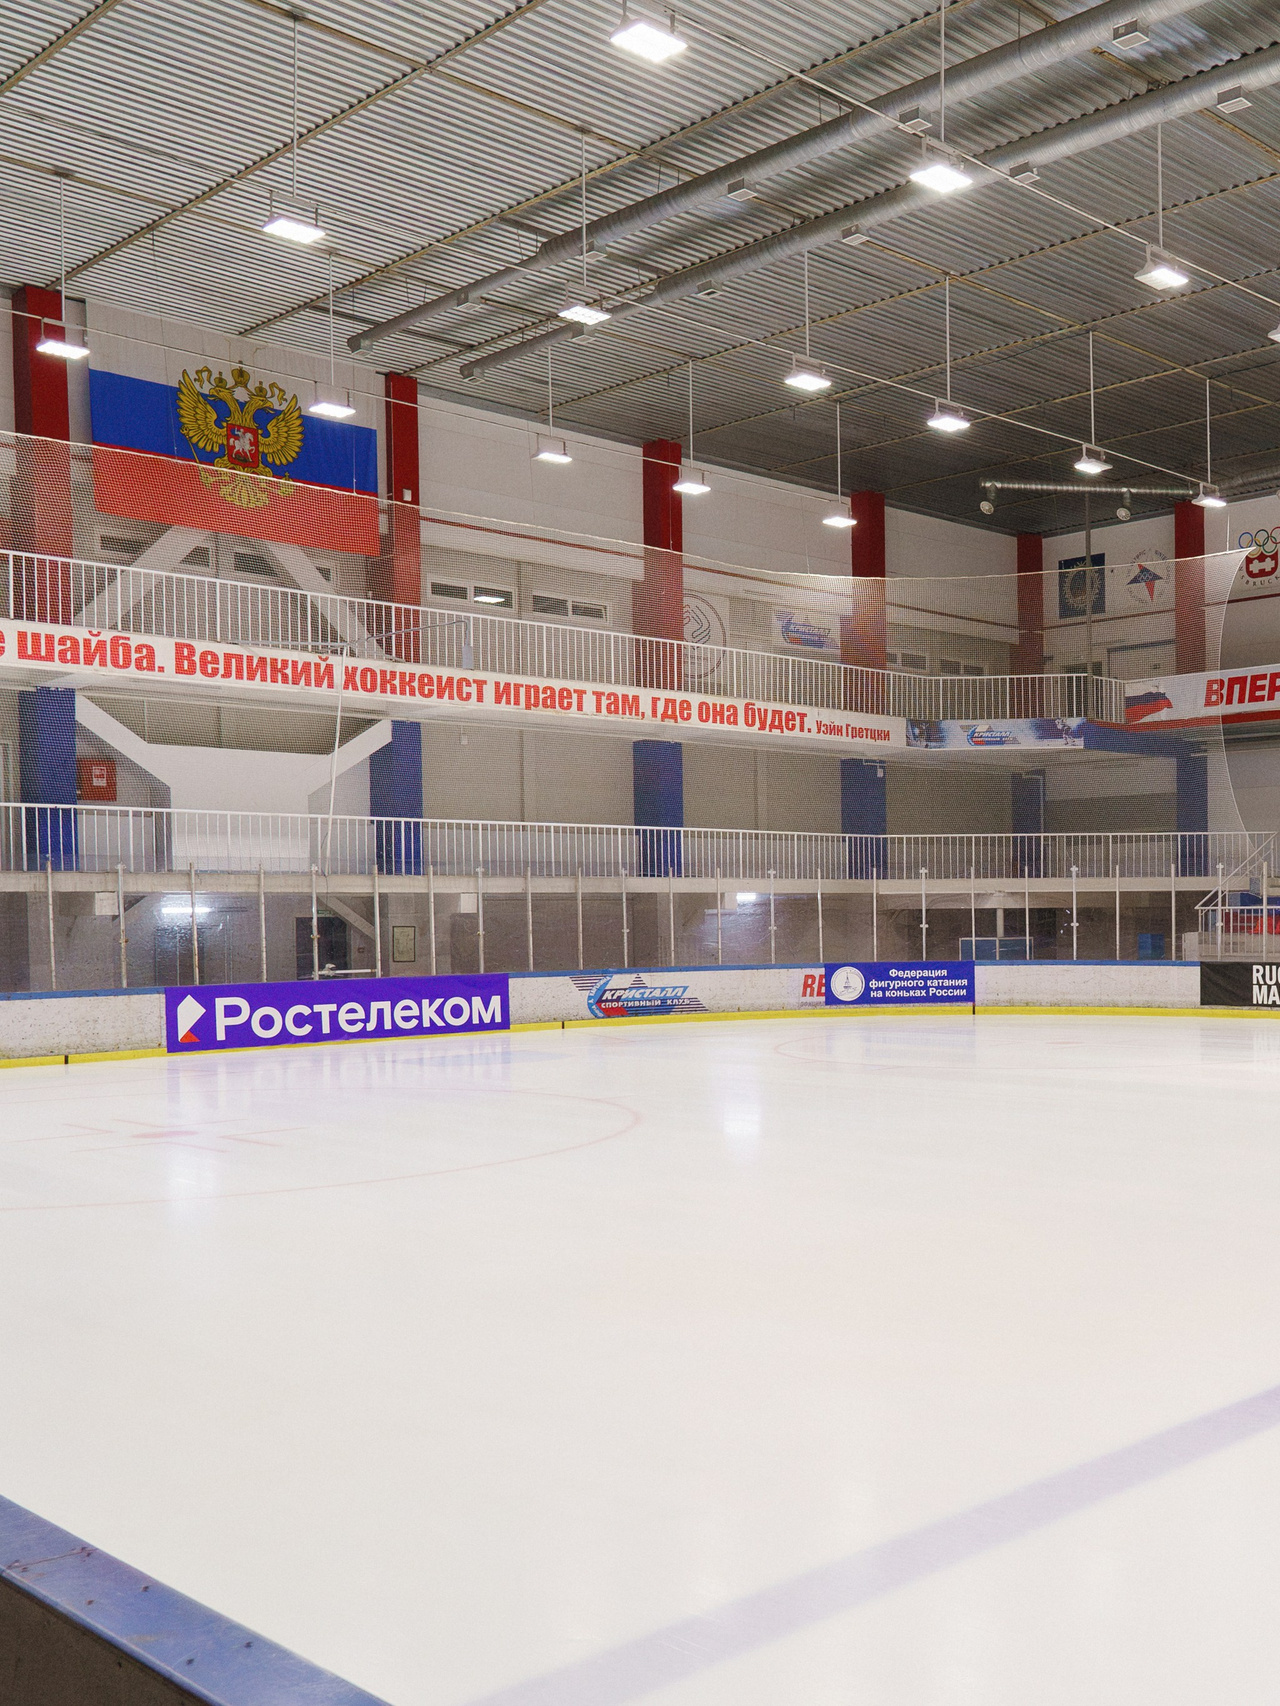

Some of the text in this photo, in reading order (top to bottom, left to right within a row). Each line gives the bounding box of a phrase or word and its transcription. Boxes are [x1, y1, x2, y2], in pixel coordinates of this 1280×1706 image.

[17, 629, 165, 673] шайба.
[174, 641, 335, 690] Великий
[343, 664, 487, 703] хоккеист
[494, 681, 587, 712] играет
[592, 691, 645, 720] там,
[652, 698, 692, 724] где
[698, 702, 738, 727] она
[743, 702, 812, 735] будет.
[816, 719, 844, 737] Уэйн
[845, 723, 890, 743] Гретцки
[889, 968, 948, 979] Федерация
[869, 978, 968, 989] фигурного катания
[601, 987, 684, 1000] КРИСТАЛЛ
[870, 987, 967, 998] на коньках России
[601, 999, 661, 1008] СПОРТИВНЫЙ
[215, 994, 503, 1041] Ростелеком
